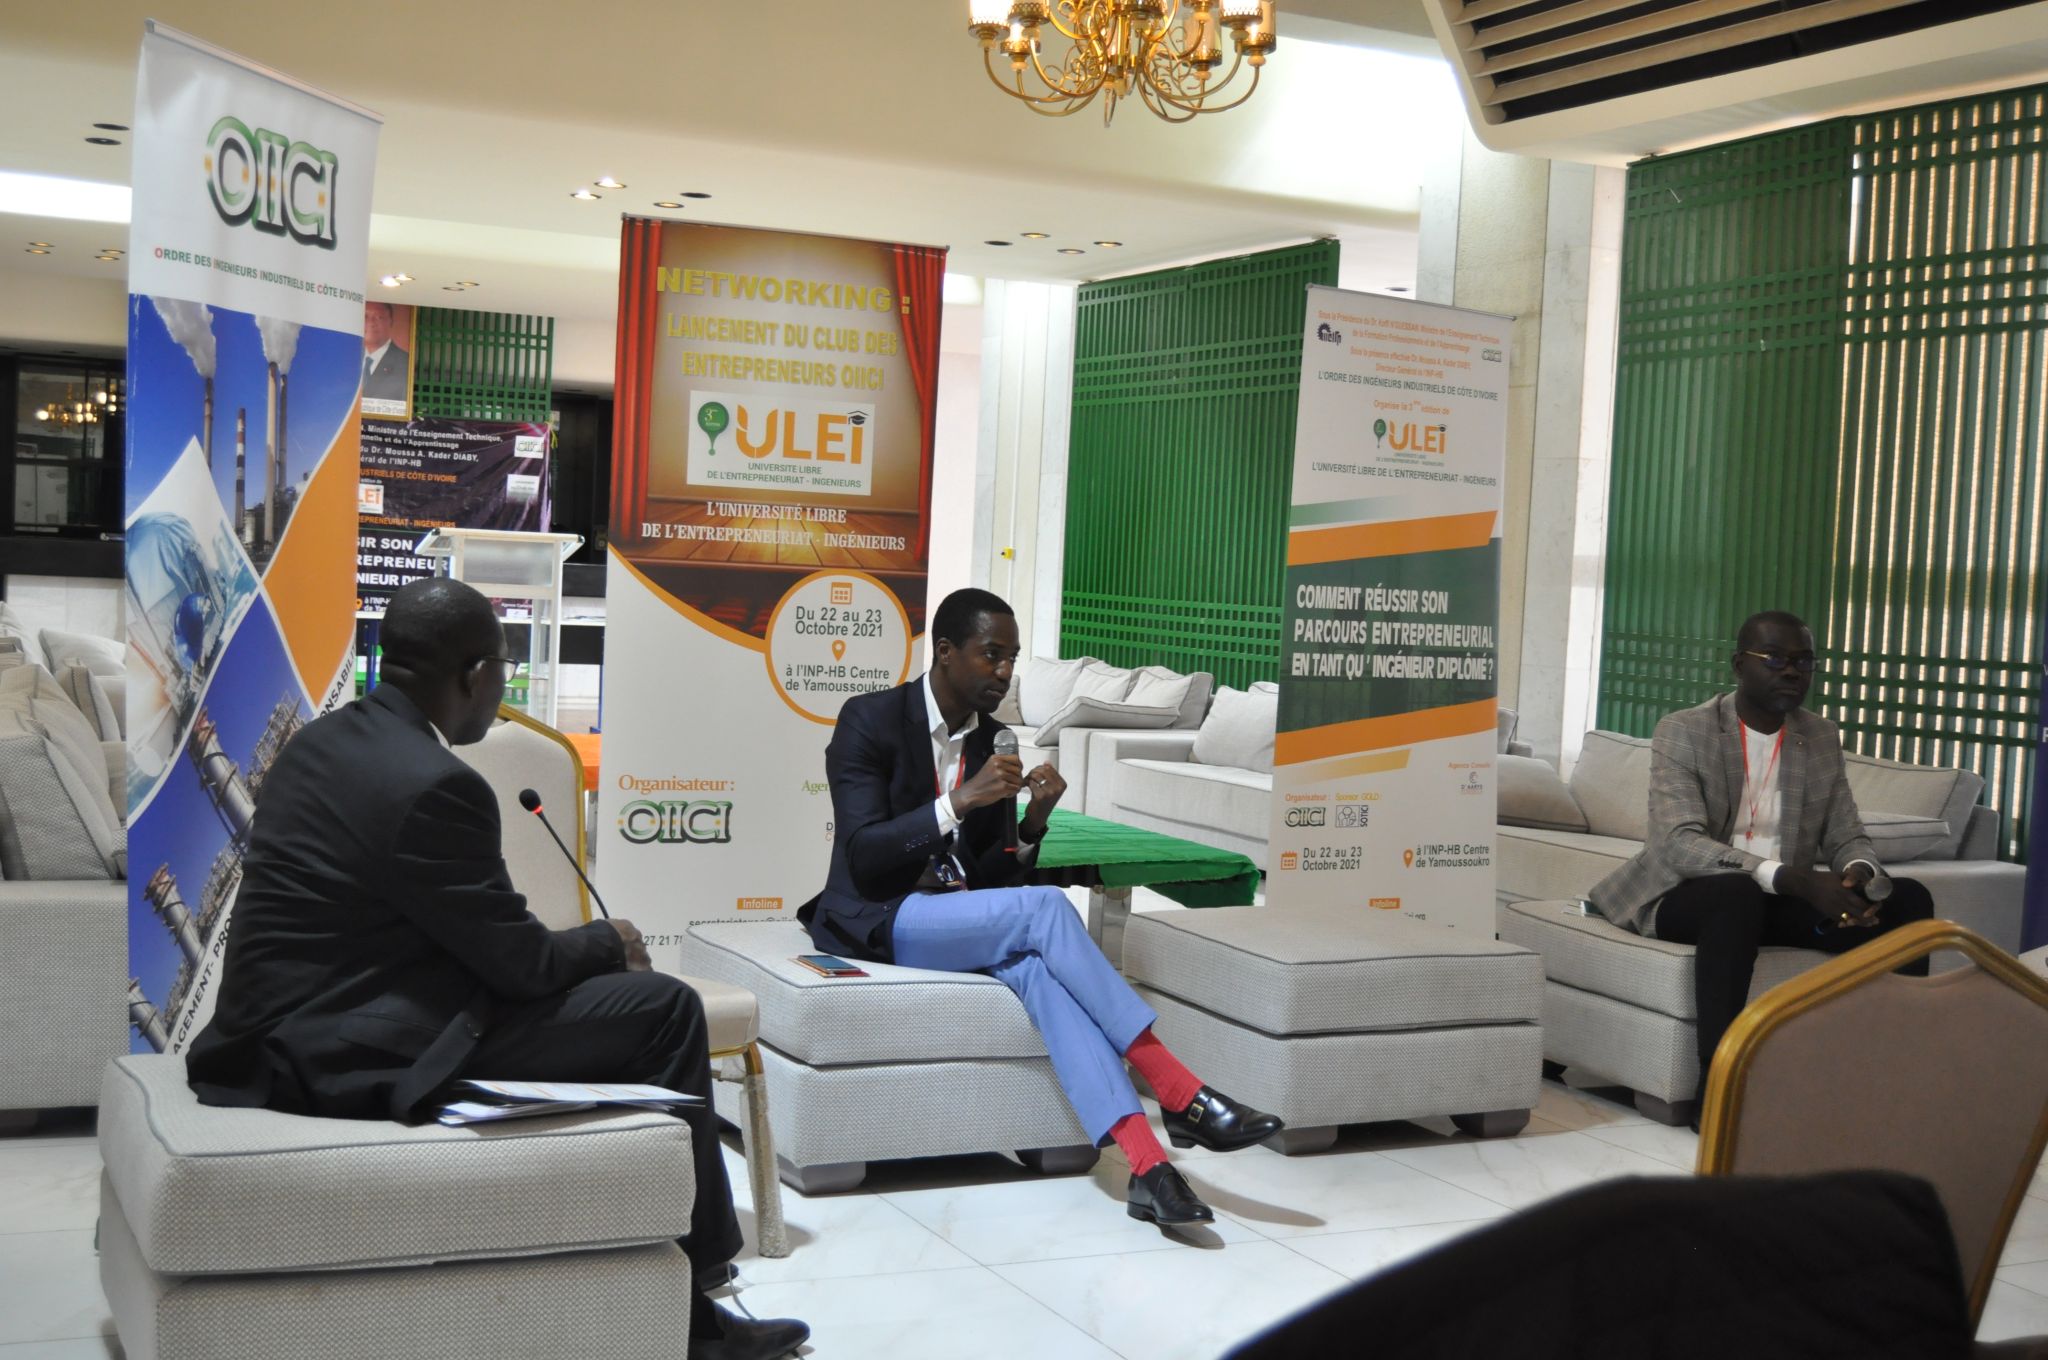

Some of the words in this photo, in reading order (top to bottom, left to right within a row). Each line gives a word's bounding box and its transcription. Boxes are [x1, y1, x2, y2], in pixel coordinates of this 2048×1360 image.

[155, 247, 191, 264] ORDRE
[194, 254, 212, 268] DES
[260, 270, 304, 290] INDUSTRIELS
[306, 282, 315, 293] DE
[657, 267, 891, 312] NETWORKING
[667, 313, 778, 346] LANCEMENT
[784, 323, 808, 348] DU
[813, 325, 859, 353] CLUB
[865, 331, 897, 355] DES
[682, 352, 836, 386] ENTREPRENEURS
[1318, 371, 1347, 382] L'ORDRE
[1349, 375, 1362, 384] DES
[1404, 381, 1446, 394] INDUSTRIELS
[1447, 386, 1456, 395] DE
[368, 425, 397, 435] Ministre
[399, 428, 408, 436] de
[410, 429, 463, 440] l'Enseignement
[386, 448, 415, 457] Moussa
[748, 463, 796, 473] UNIVERSITE
[1358, 467, 1376, 476] LIBRE
[1378, 468, 1387, 477] DE
[1389, 469, 1458, 482] L'ENTREPRENEURIAT
[708, 471, 718, 479] DE
[720, 472, 803, 484] L'ENTREPRENEURIAT
[812, 478, 861, 488] INGENIEURS
[707, 502, 802, 521] L'UNIVERSITÉ
[806, 507, 846, 523] LIBRE
[381, 538, 412, 550] SON
[641, 523, 660, 537] DE
[665, 524, 812, 546] L'ENTREPRENEURIAT
[824, 531, 905, 551] INGÉNIEURS
[1297, 585, 1361, 610] COMMENT
[1365, 583, 1418, 613] RÉUSSIR
[1422, 590, 1448, 614] SON
[796, 606, 814, 620] Du
[821, 608, 836, 620] 22
[843, 611, 859, 622] au
[866, 609, 882, 622] 23
[796, 621, 848, 636] Octobre
[853, 623, 882, 637] 2021
[1294, 619, 1367, 644] PARCOURS
[1372, 621, 1494, 648] ENTREPRENEURIAL
[786, 665, 792, 677] à
[797, 665, 846, 678] l'INP-HB
[850, 666, 889, 679] Centre
[1292, 653, 1310, 676] EN
[1313, 653, 1344, 676] TANT
[786, 679, 799, 691] de
[804, 680, 890, 693] Yamoussoukro
[1304, 848, 1316, 858] Du
[1320, 848, 1331, 858] 22
[1335, 849, 1346, 858] au
[1351, 847, 1362, 857] 23
[1417, 846, 1421, 855] à
[1424, 845, 1460, 855] l'INP-HB
[1463, 845, 1489, 855] Centre
[1303, 860, 1338, 871] Octobre
[1340, 859, 1360, 870] 2021
[1416, 858, 1425, 867] de
[1429, 857, 1490, 867] Yamoussoukro
[743, 899, 778, 909] Infoline
[644, 936, 655, 946] 27
[659, 936, 669, 945] 21
